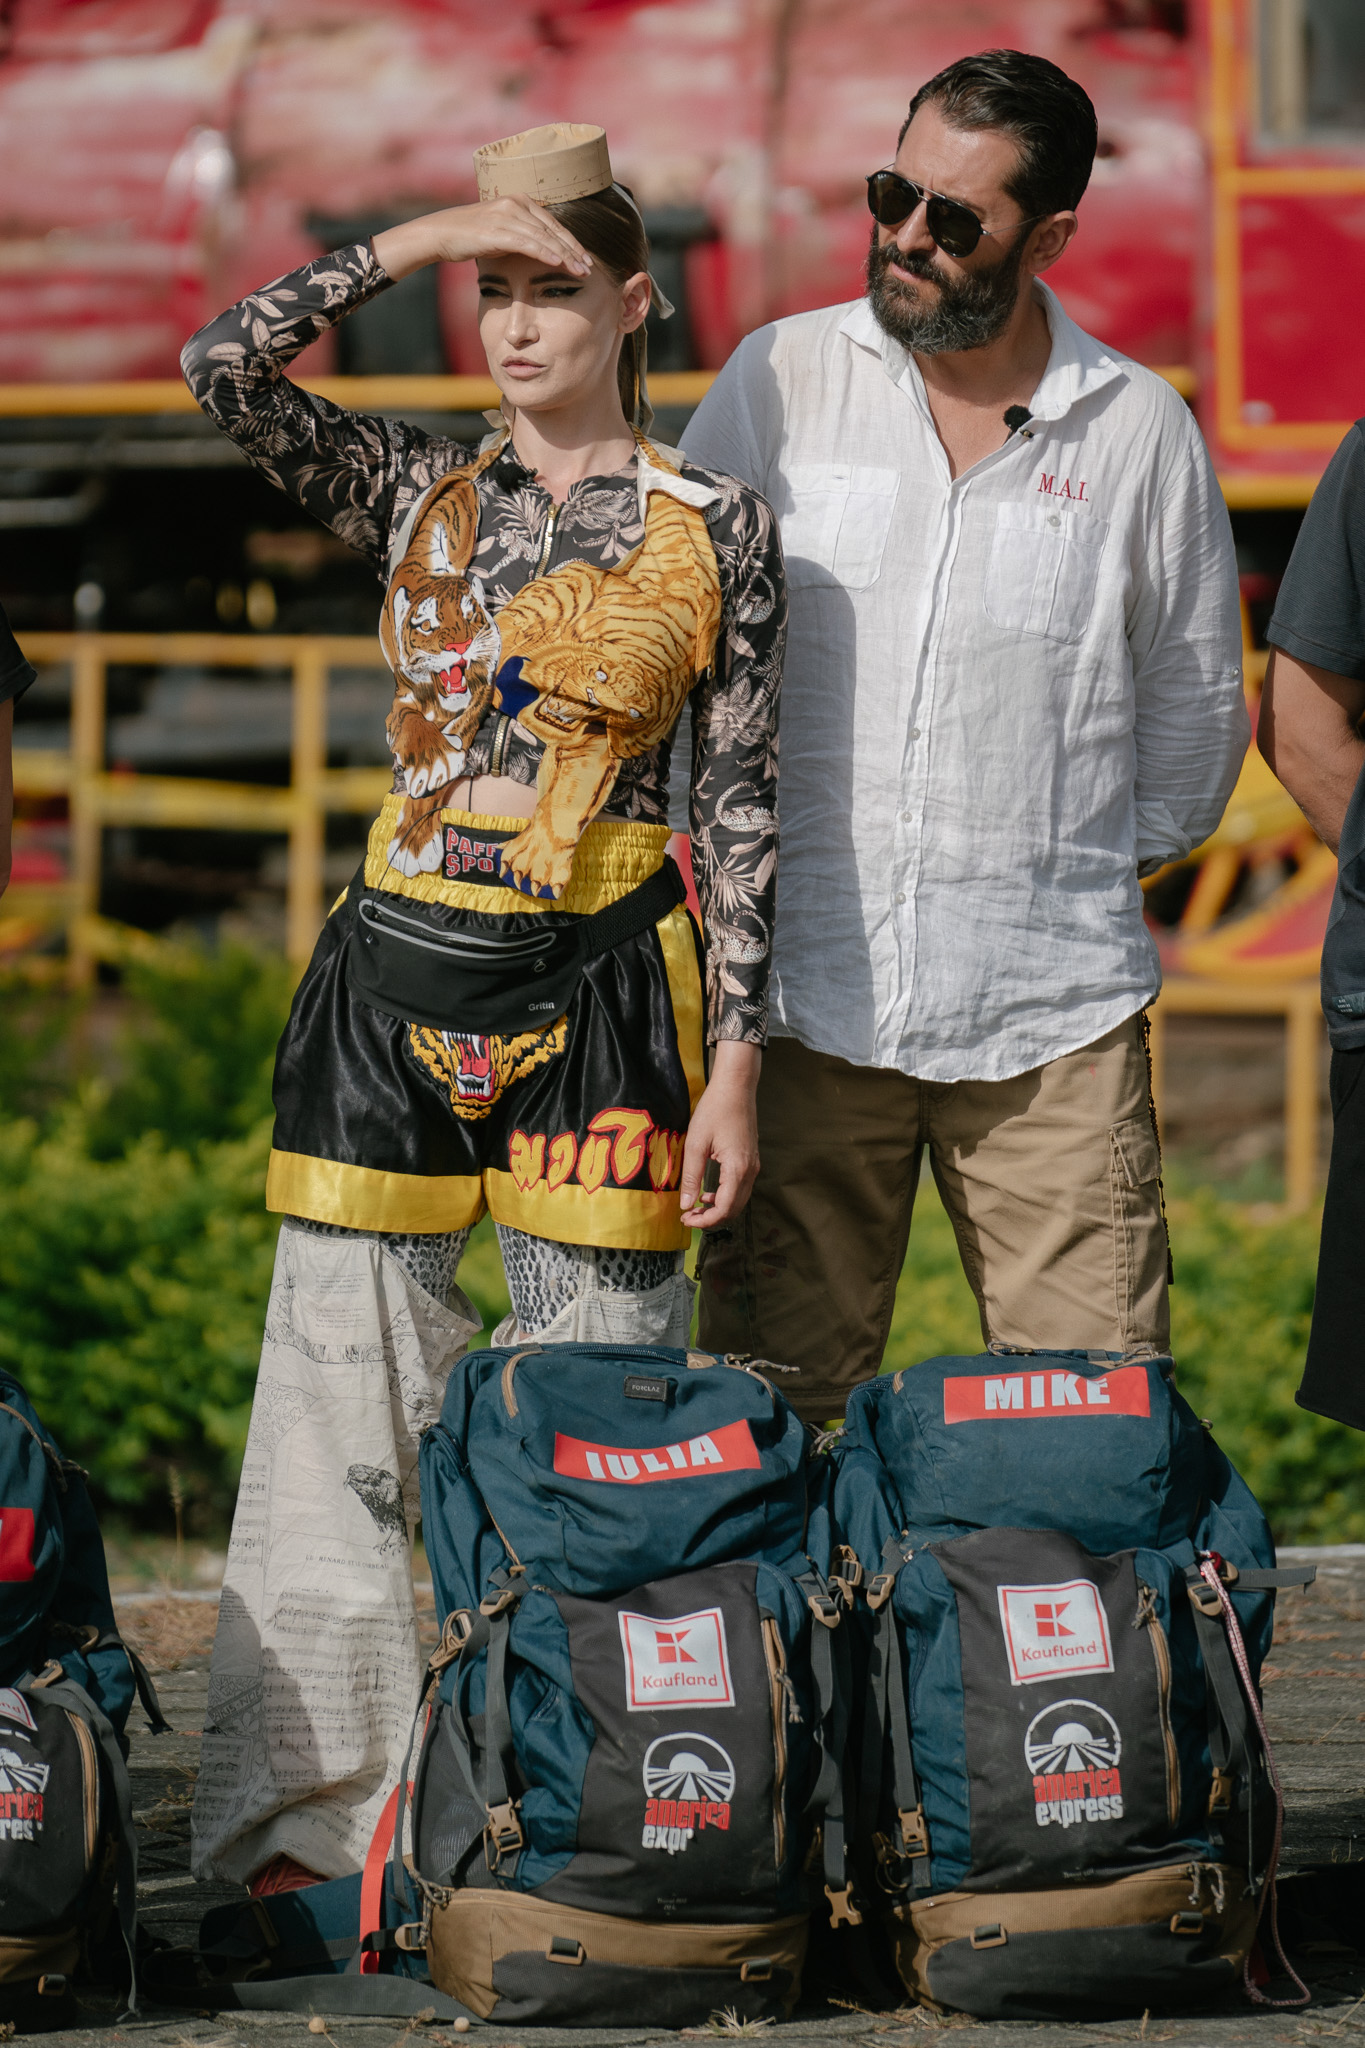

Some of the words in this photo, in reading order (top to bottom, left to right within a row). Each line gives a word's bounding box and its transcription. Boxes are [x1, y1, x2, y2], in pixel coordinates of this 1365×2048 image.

[1037, 472, 1089, 502] M.A.I.
[528, 1001, 555, 1011] Gritin
[631, 1384, 661, 1393] FORCLAZ
[984, 1373, 1111, 1410] MIKE
[585, 1435, 724, 1480] IULIA
[1021, 1640, 1097, 1662] Kaufland
[642, 1671, 718, 1690] Kaufland
[1032, 1764, 1121, 1803] america
[644, 1795, 730, 1830] america
[1035, 1795, 1123, 1828] express
[641, 1824, 694, 1855] expr
